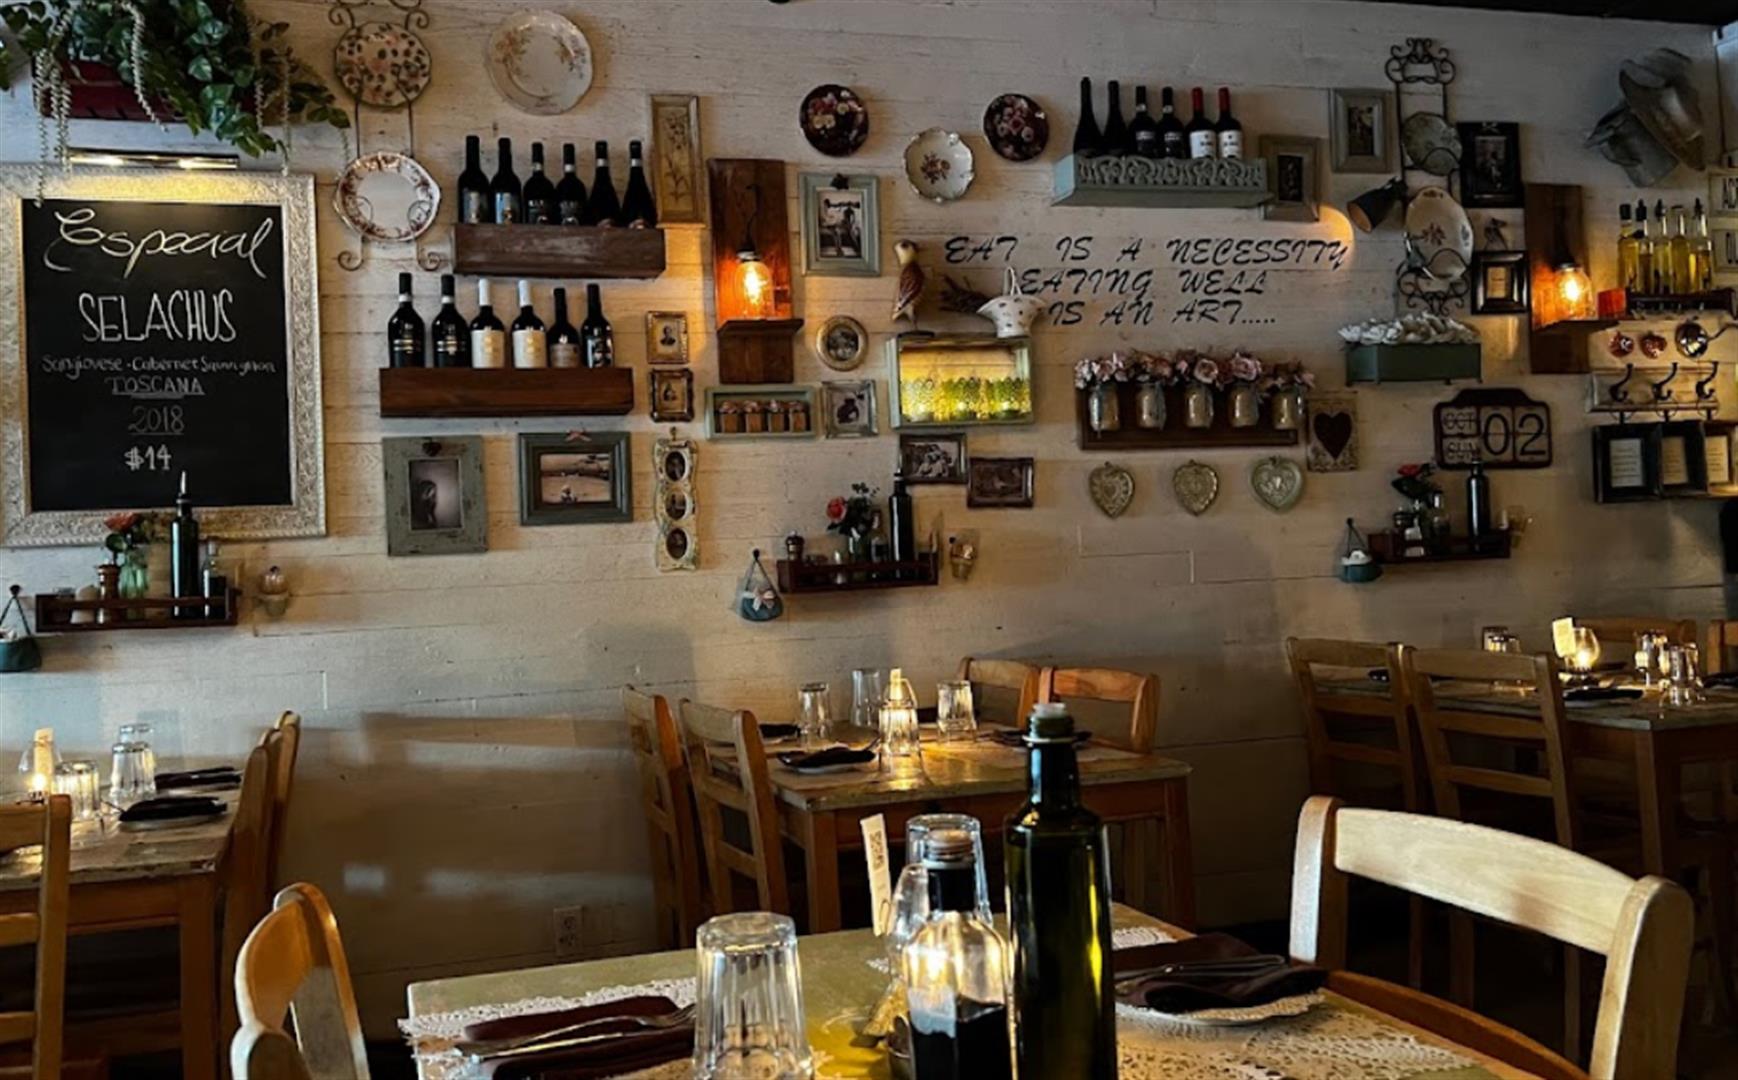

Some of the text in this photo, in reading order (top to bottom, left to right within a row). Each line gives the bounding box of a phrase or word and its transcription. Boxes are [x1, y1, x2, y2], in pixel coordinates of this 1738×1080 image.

[43, 207, 274, 280] Especial
[945, 236, 1350, 270] EAT IS A NECESSITY
[1020, 269, 1269, 299] EATING WELL
[78, 287, 237, 343] SELACHUS
[1048, 300, 1085, 327] IS
[1099, 300, 1155, 327] AN
[104, 374, 206, 395] TOSCANA
[128, 405, 185, 434] 2018
[1444, 411, 1475, 431] OCT
[124, 442, 172, 472] $14
